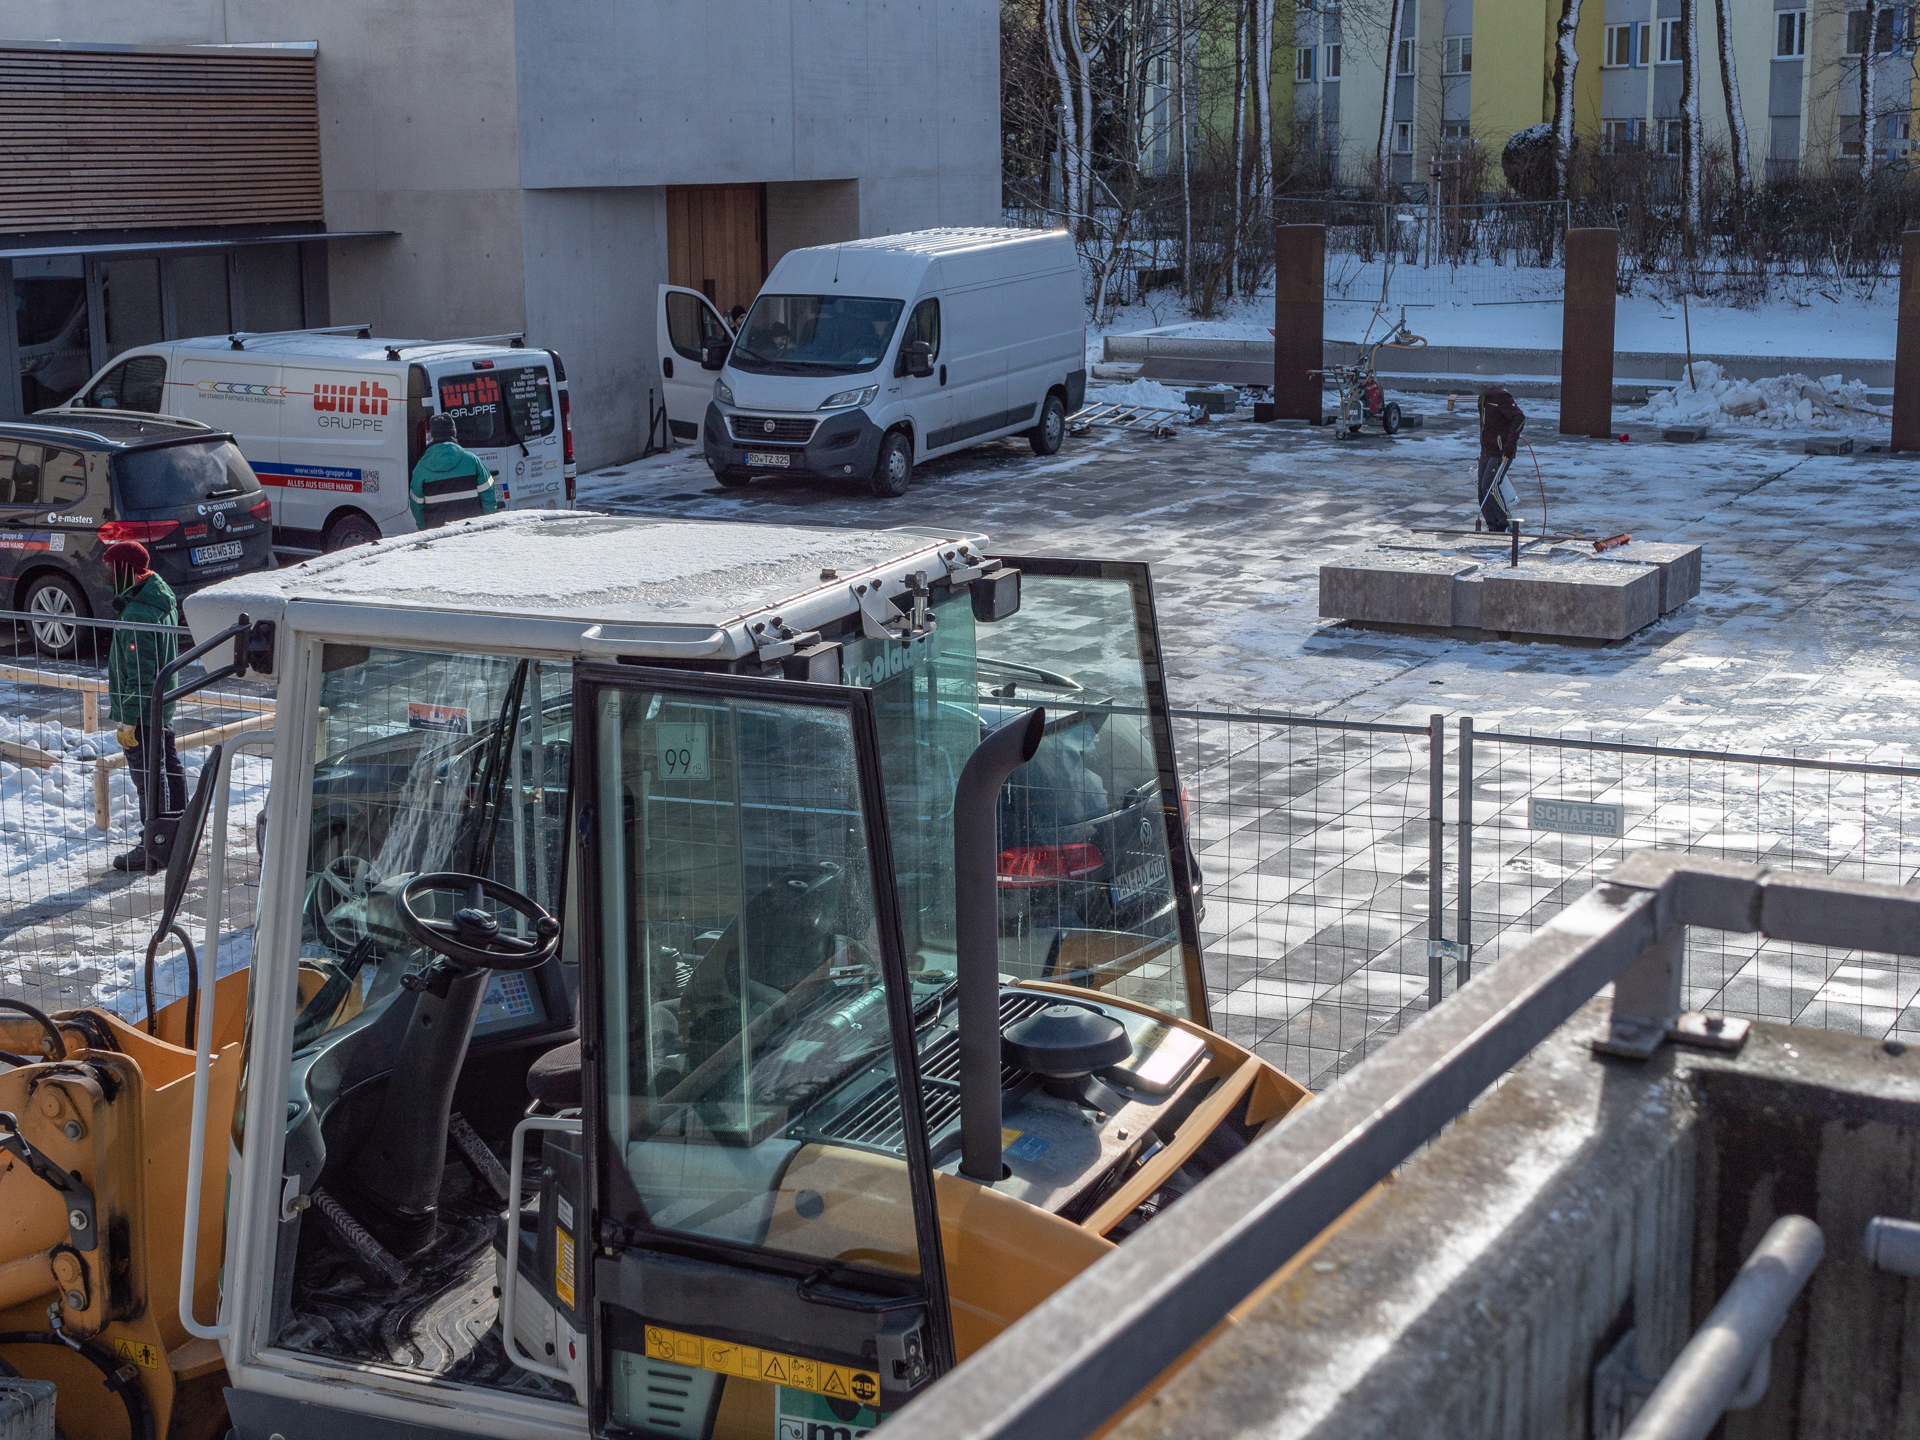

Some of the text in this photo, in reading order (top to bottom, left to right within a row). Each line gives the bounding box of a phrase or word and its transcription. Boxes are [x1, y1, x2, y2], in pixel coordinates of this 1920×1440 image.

[313, 381, 388, 416] wirth
[441, 376, 500, 408] wirth
[317, 416, 384, 432] GRUPPE
[294, 466, 354, 478] www.wirth-gruppe.de
[287, 479, 354, 492] ALLES AUS EINER HAND
[207, 501, 237, 513] e-masters
[57, 514, 93, 524] e-masters
[196, 547, 213, 561] DEG
[216, 544, 228, 558] WG
[227, 542, 242, 556] 373
[665, 748, 703, 775] 99 dB
[1534, 804, 1617, 826] SCHÄFER
[1533, 820, 1618, 835] VERLEIHSERVICE
